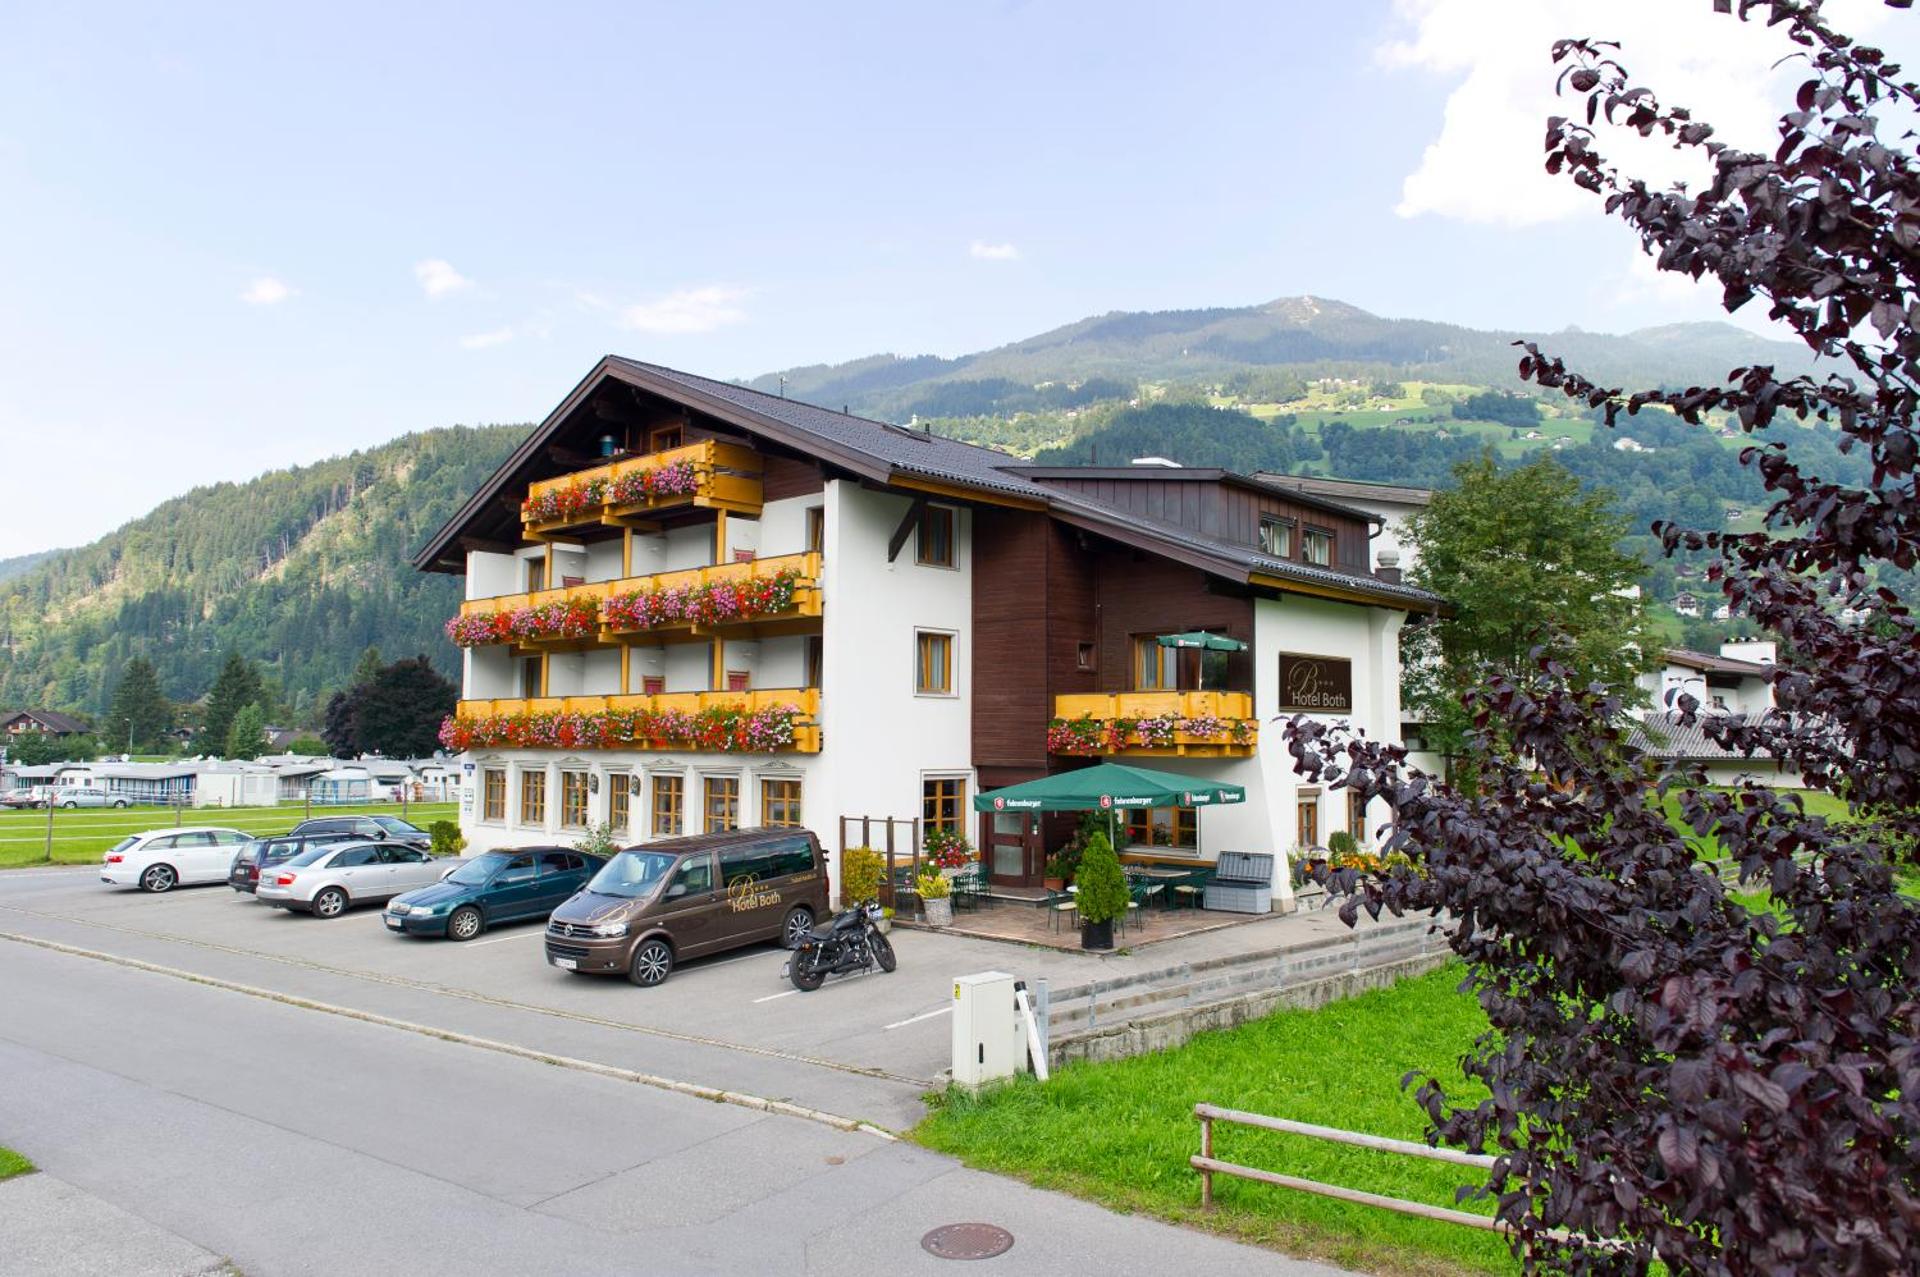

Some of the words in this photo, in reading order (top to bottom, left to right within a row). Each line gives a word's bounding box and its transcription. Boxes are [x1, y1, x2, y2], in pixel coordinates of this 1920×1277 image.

[1292, 691, 1320, 706] Hotel
[1322, 692, 1346, 707] Both
[732, 895, 758, 912] Hotel
[759, 891, 781, 907] Both
